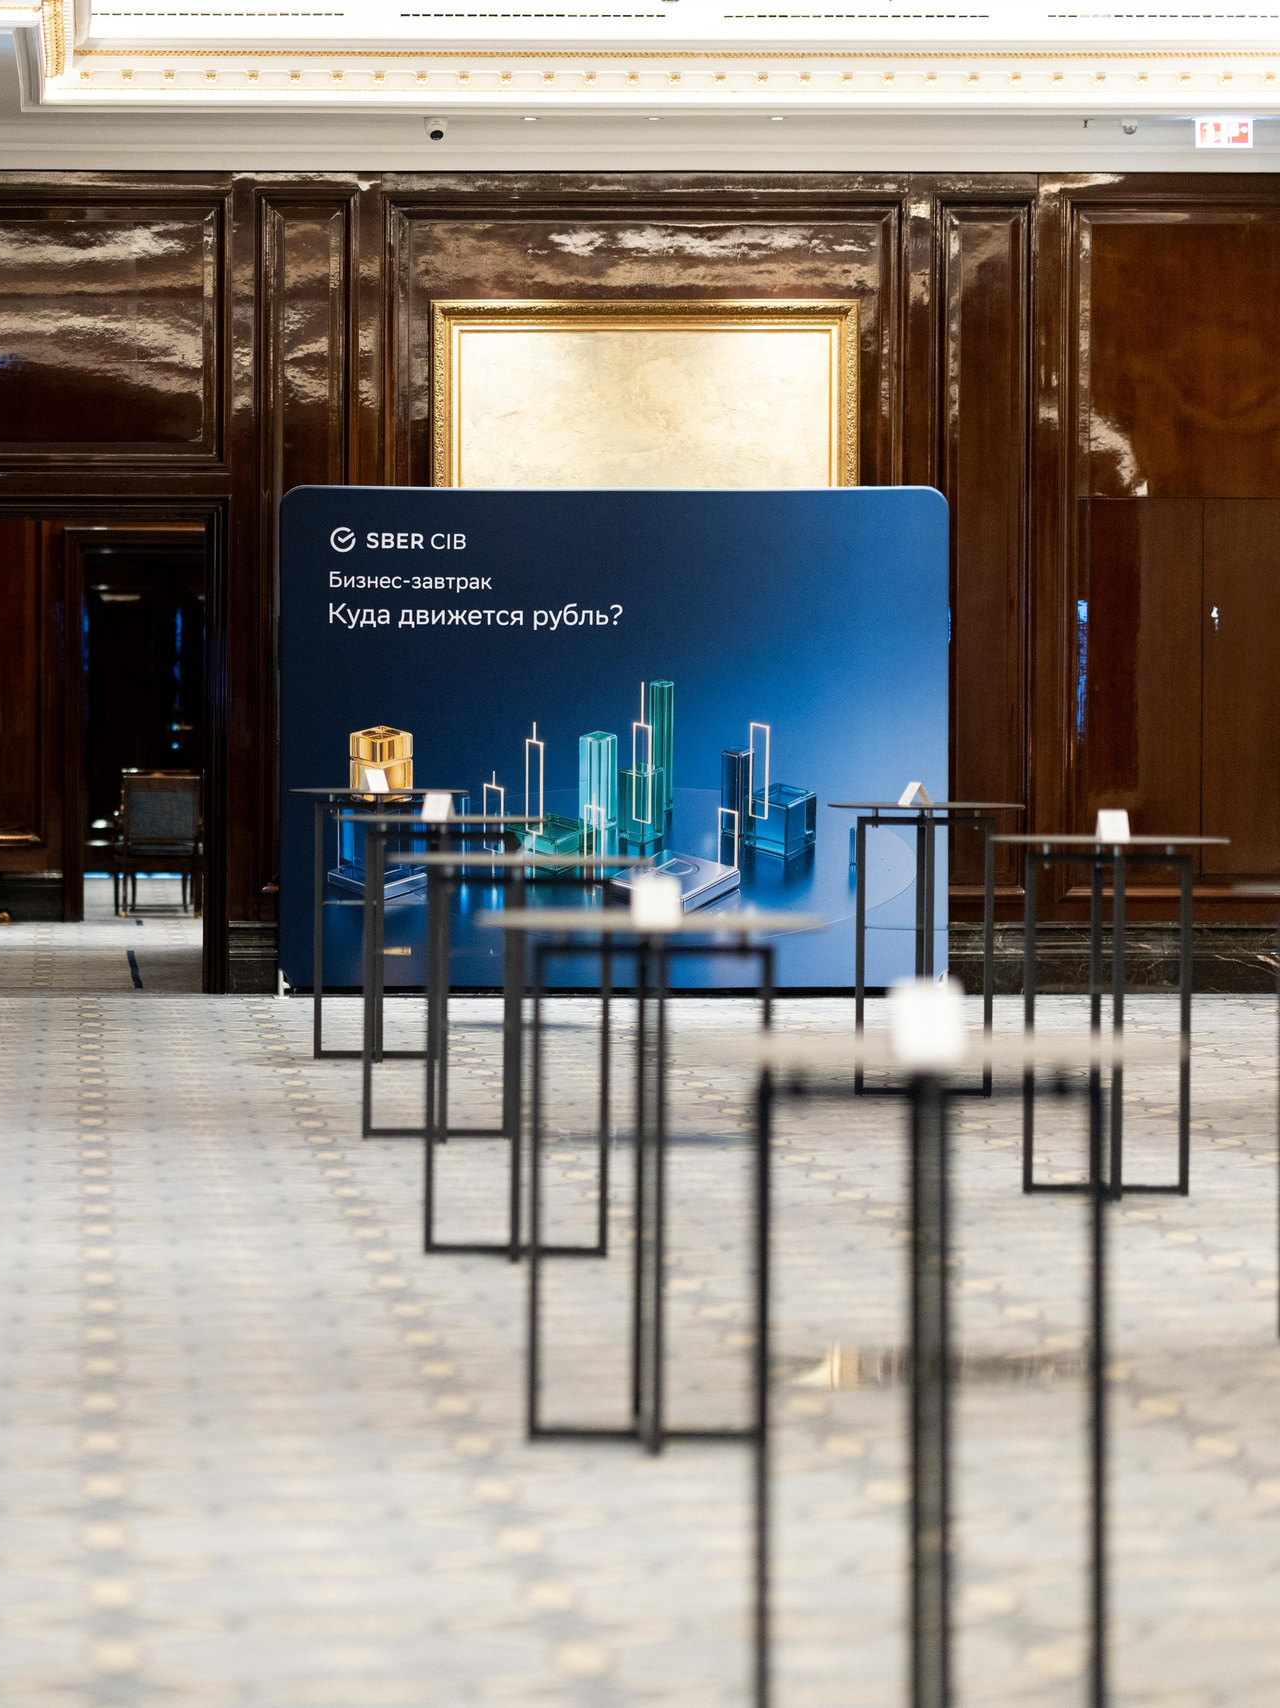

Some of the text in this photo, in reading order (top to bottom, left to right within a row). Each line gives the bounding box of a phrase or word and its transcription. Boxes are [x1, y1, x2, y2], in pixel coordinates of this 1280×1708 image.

[366, 532, 467, 550] SBER CIB
[328, 571, 493, 593] Бизнес-завтрак
[328, 602, 624, 631] Куда движется рубль?
